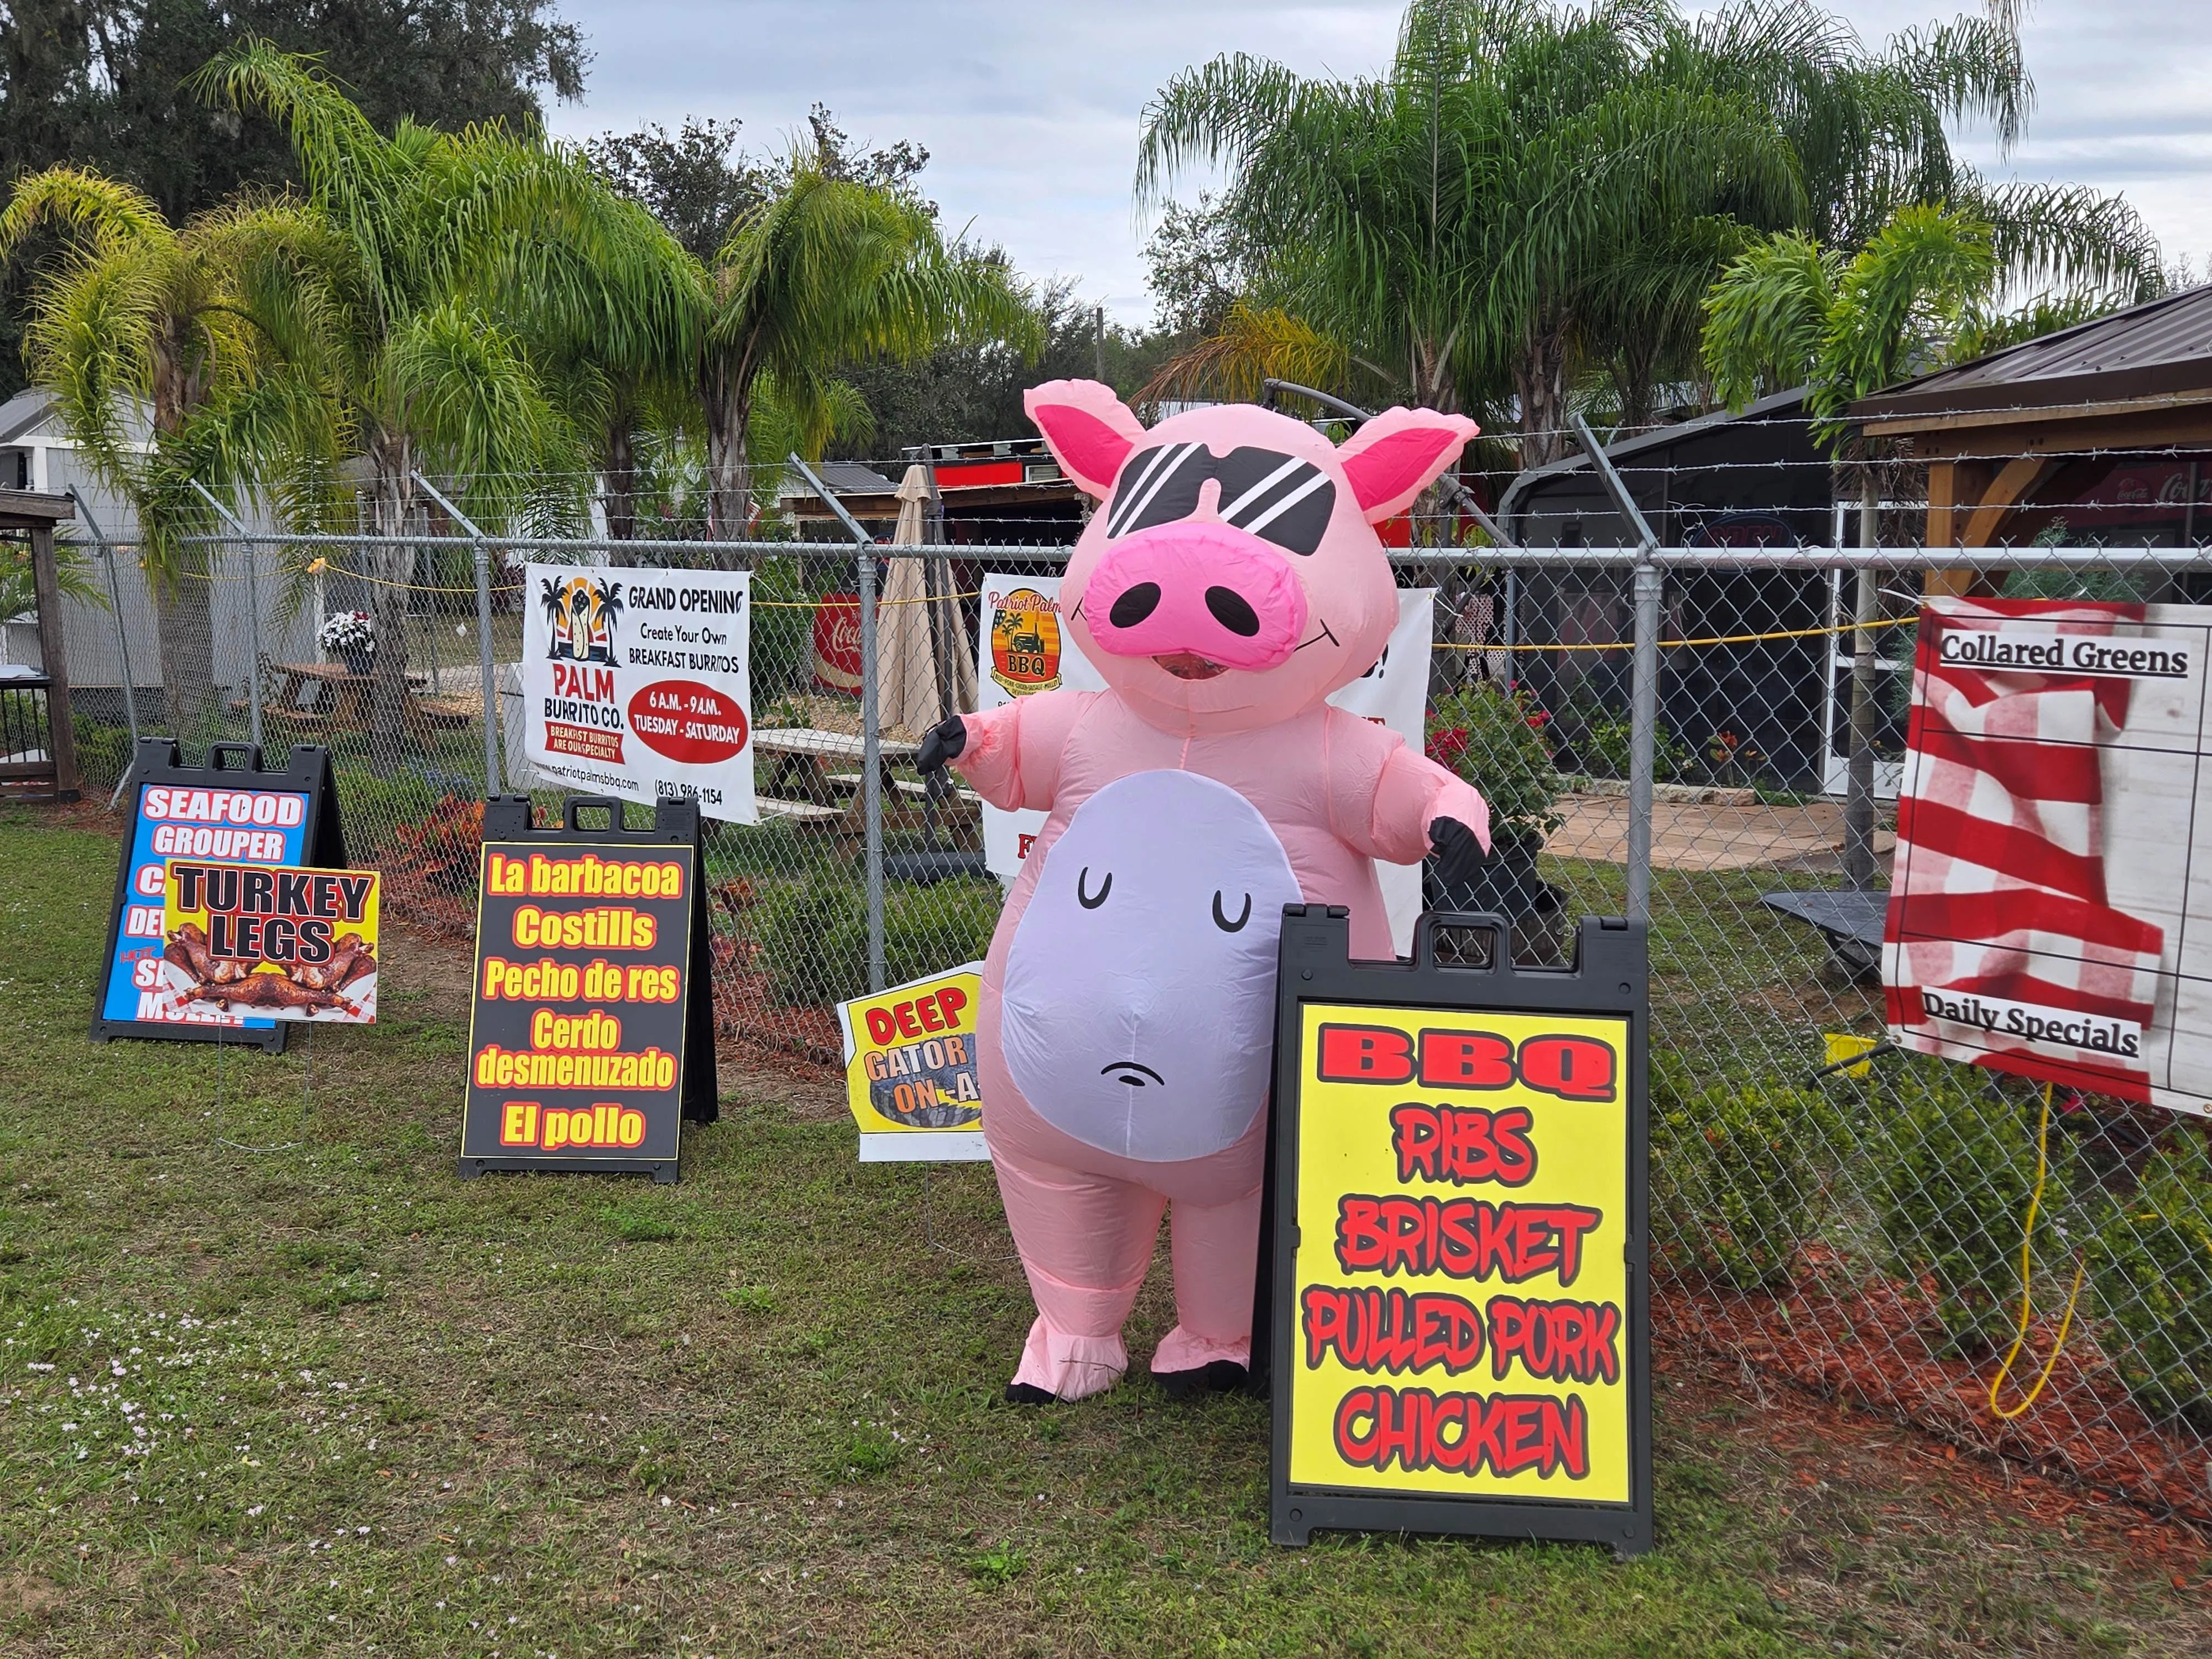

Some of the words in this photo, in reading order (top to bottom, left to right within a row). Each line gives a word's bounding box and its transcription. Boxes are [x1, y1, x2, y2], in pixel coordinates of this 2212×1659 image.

[629, 586, 676, 610] GRAND
[988, 591, 1029, 611] Patriot
[1030, 593, 1062, 613] Palm
[640, 622, 673, 641] Create
[675, 625, 699, 643] Your
[702, 627, 727, 645] Own
[629, 648, 686, 669] BREAKFAST
[689, 653, 739, 673] BURRITOS
[1007, 655, 1045, 677] BBQ
[1941, 634, 2065, 667] Collared
[2072, 641, 2188, 674] Greens
[552, 663, 615, 705] PALM
[649, 691, 656, 708] 6
[658, 692, 682, 711] A.M.
[545, 698, 598, 726] BURRITO
[602, 707, 624, 730] CO.
[634, 714, 679, 735] TUESDAY
[685, 721, 740, 744] SATURDAY
[554, 738, 567, 750] ARE
[589, 732, 619, 748] BURRITOS
[145, 790, 301, 825] SEAFOOD
[655, 779, 679, 797] (813)
[680, 784, 722, 805] 986-1154
[155, 827, 283, 859] GROUPER
[175, 868, 374, 919] TURKEY
[491, 857, 524, 893] La
[531, 858, 679, 895] barbacoa
[211, 915, 331, 962] LEGS
[516, 909, 654, 946] Costills
[486, 961, 578, 998] Pecho
[585, 963, 622, 998] de
[629, 969, 677, 999] res
[534, 1011, 617, 1049] Cerdo
[865, 987, 967, 1045] DEEP
[1923, 992, 2000, 1032] Daily
[2006, 1008, 2140, 1055] Specials
[478, 1048, 675, 1087] desmenuzado
[864, 1036, 968, 1082] GATOR
[1319, 1024, 1615, 1100] BBQ
[504, 1105, 538, 1143] El
[544, 1107, 643, 1146] pollo
[1392, 1105, 1536, 1185] RIBS
[1336, 1196, 1601, 1284] BRISKET
[1303, 1286, 1483, 1373] PULLED
[1488, 1297, 1619, 1383] PORK
[1335, 1387, 1587, 1478] CHICKEN
